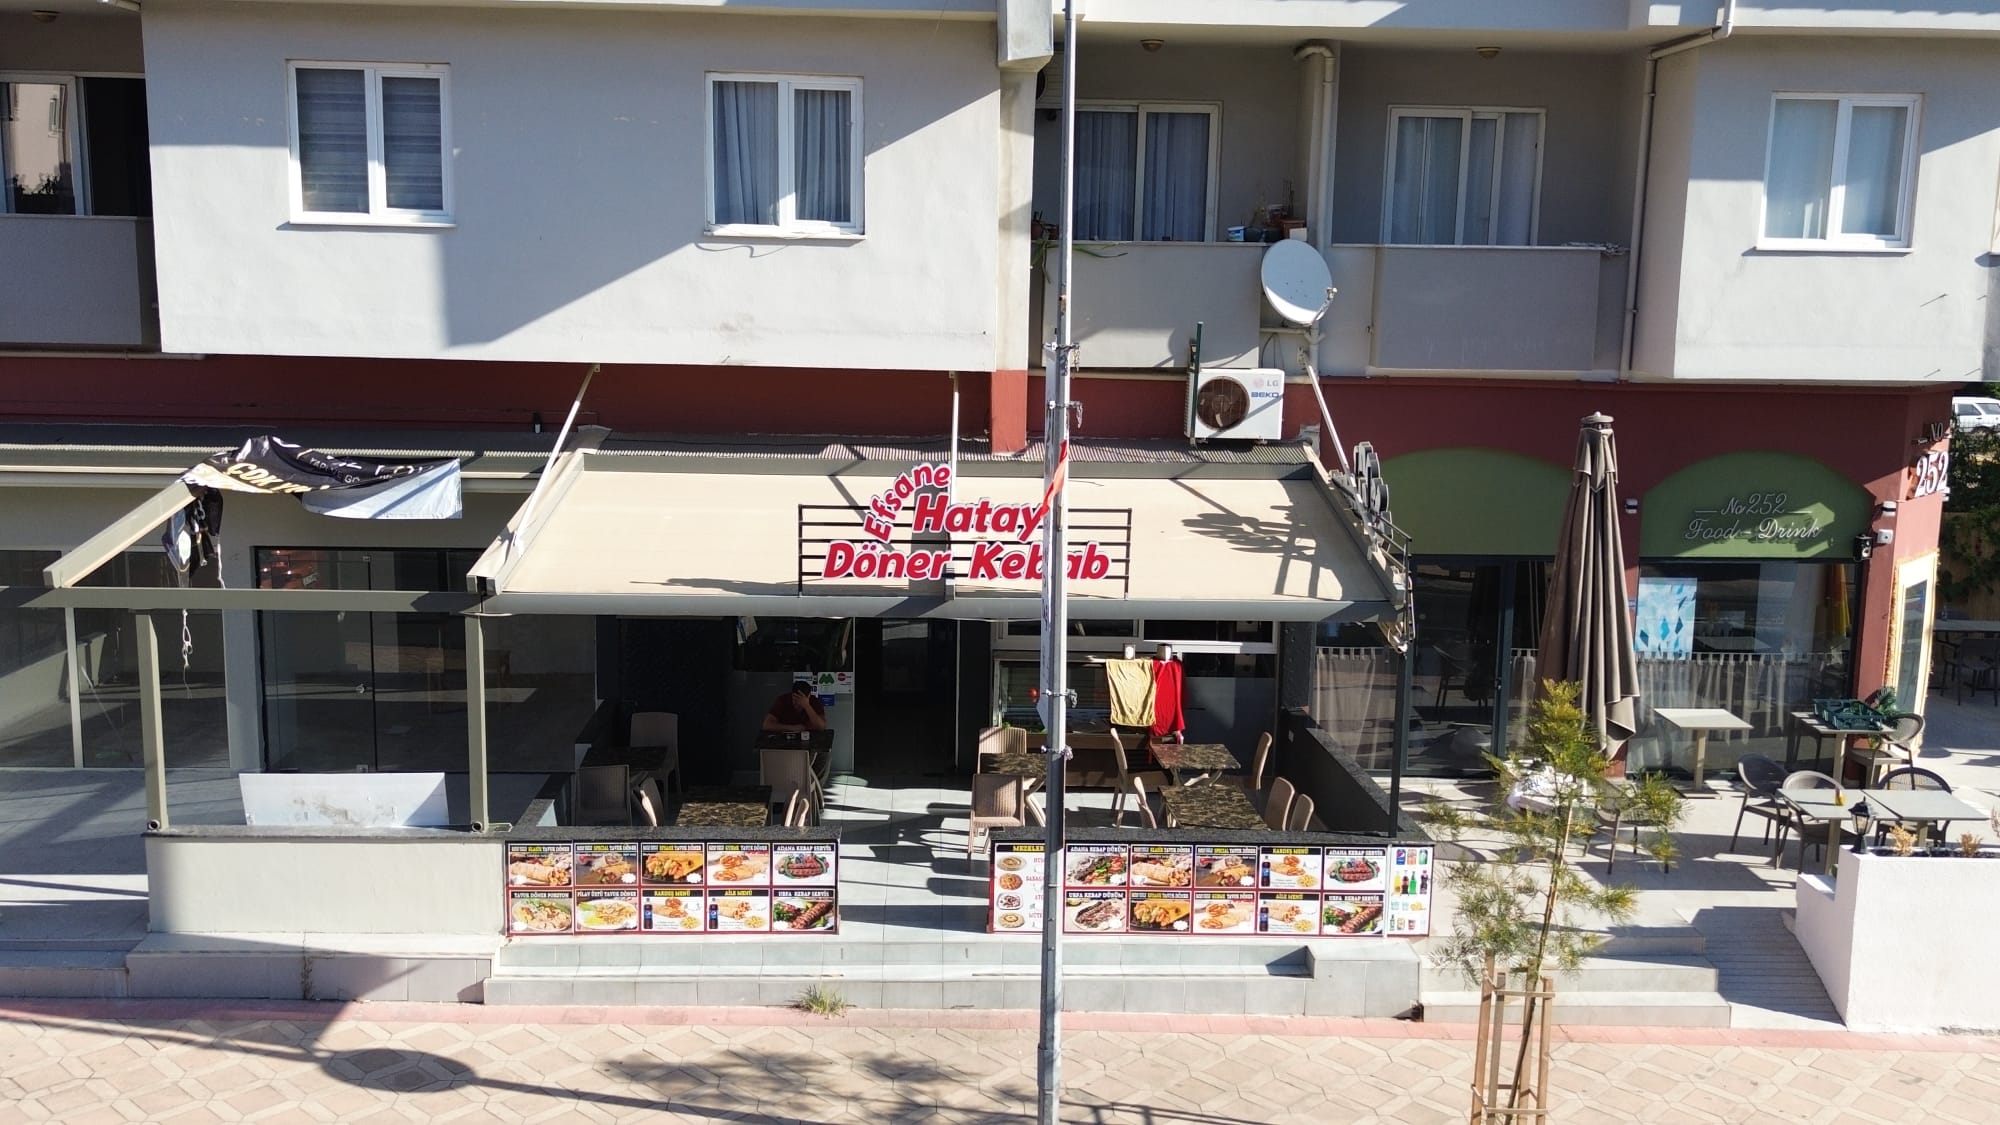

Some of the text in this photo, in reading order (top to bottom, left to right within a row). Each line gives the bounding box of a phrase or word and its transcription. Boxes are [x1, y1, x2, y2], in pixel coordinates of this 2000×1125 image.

[1914, 451, 1949, 497] 252
[863, 463, 951, 542] Efsane
[912, 494, 1046, 542] Hatay
[1746, 493, 1787, 515] 252
[1685, 518, 1741, 540] Food
[1758, 518, 1820, 540] Drink
[823, 540, 1110, 580] Döner Kebab
